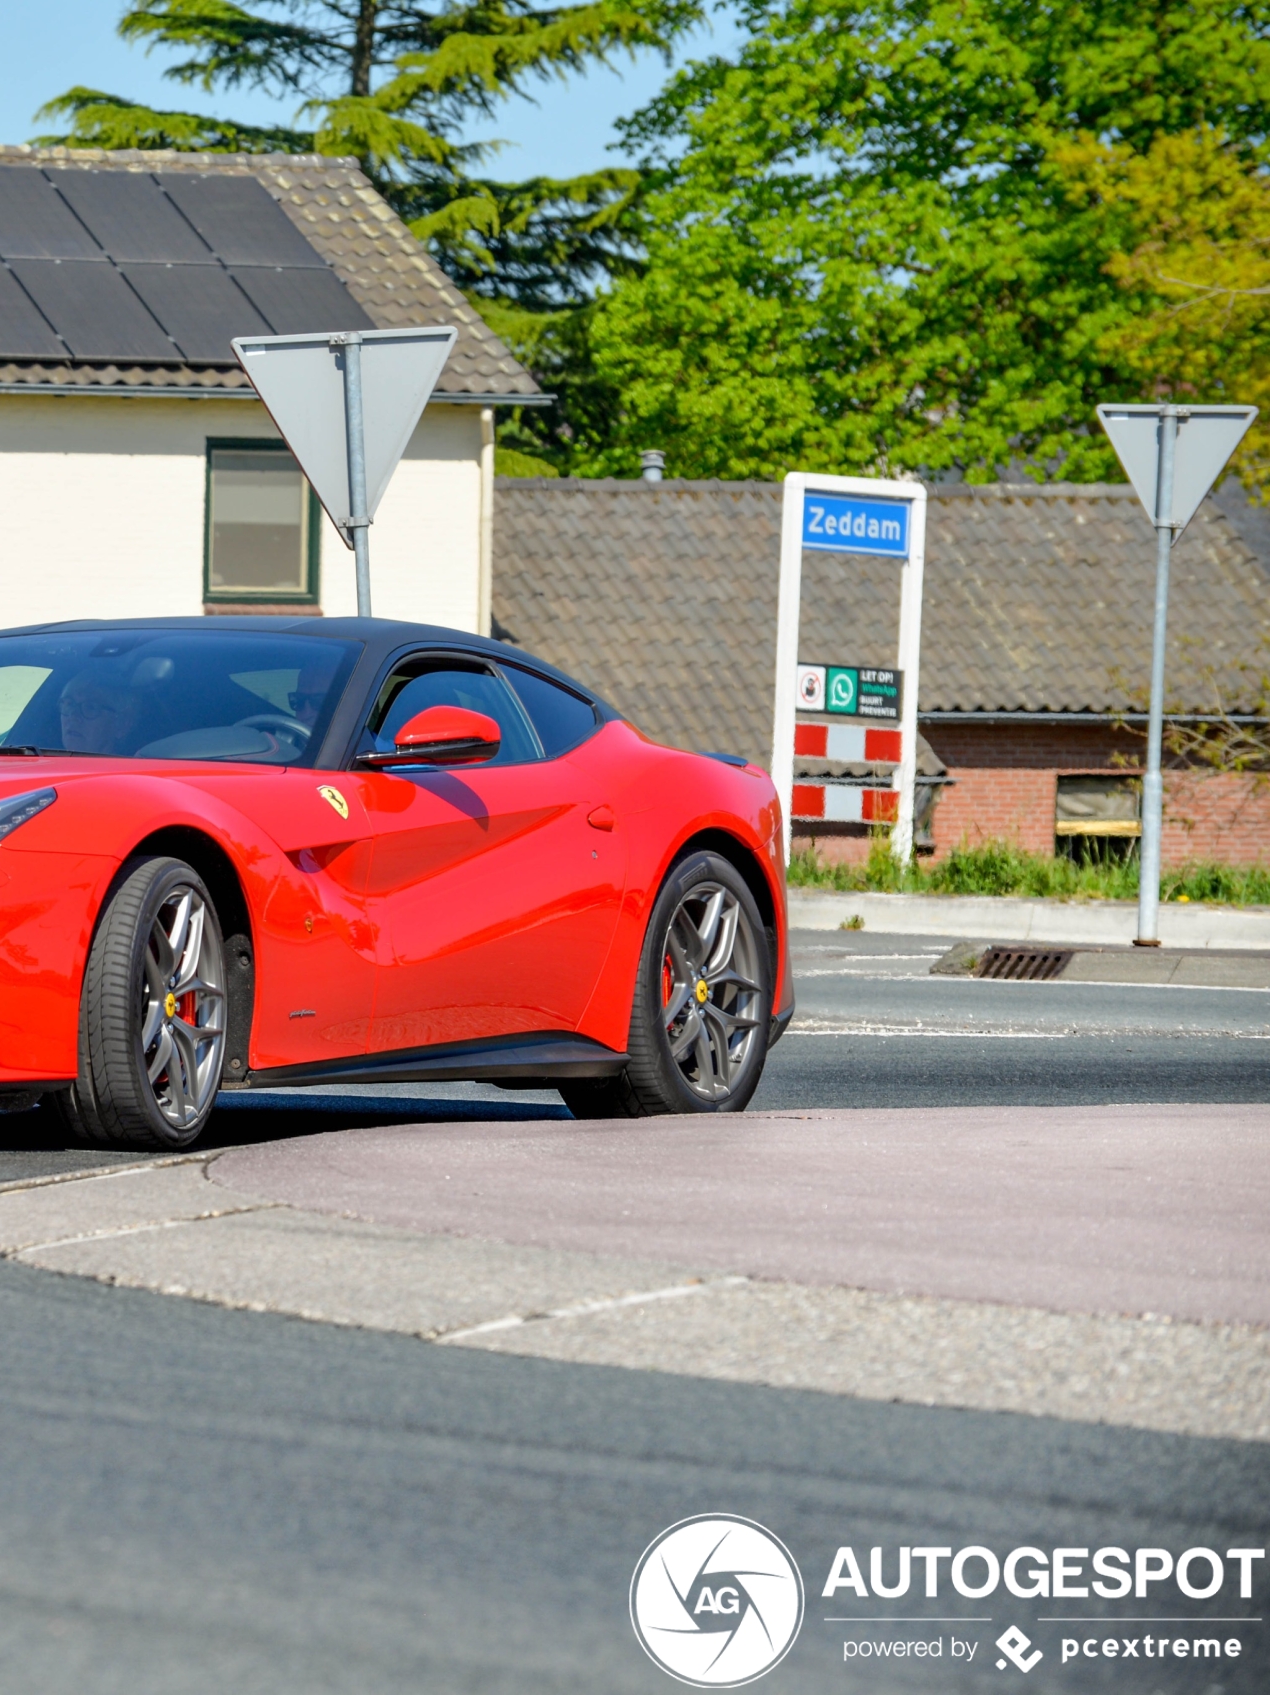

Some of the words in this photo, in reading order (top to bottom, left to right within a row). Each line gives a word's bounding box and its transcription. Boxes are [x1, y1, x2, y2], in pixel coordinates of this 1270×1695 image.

[808, 506, 901, 541] Zeddam
[861, 670, 876, 682] LET
[877, 671, 894, 683] OP!
[862, 683, 897, 697] WhatsApp
